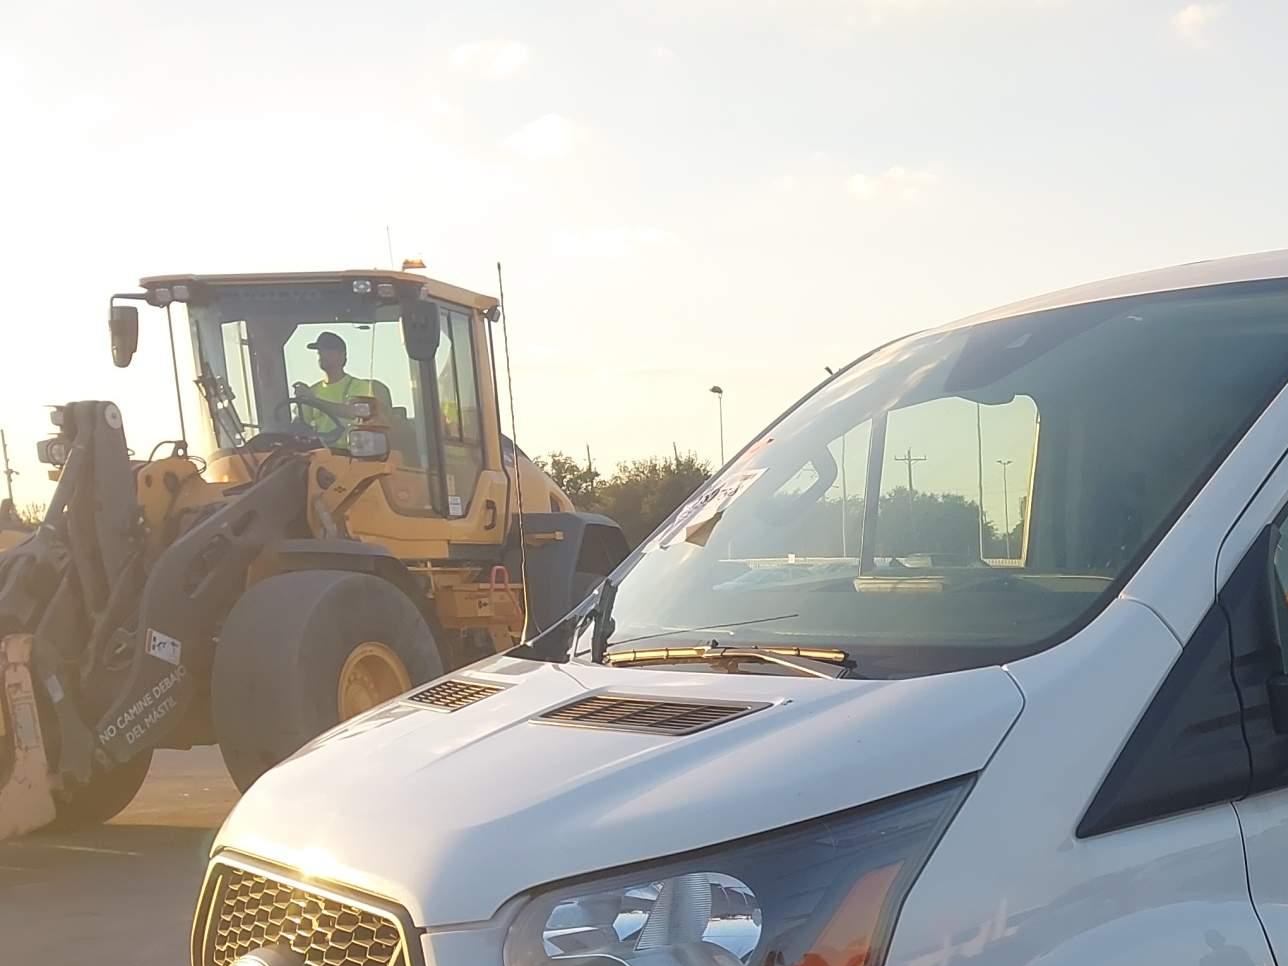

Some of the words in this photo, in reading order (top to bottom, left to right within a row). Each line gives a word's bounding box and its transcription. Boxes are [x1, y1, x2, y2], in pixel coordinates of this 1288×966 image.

[99, 725, 116, 744] NO
[117, 693, 153, 728] CAMINE
[152, 665, 186, 698] DEBAJO
[126, 724, 145, 744] DEL
